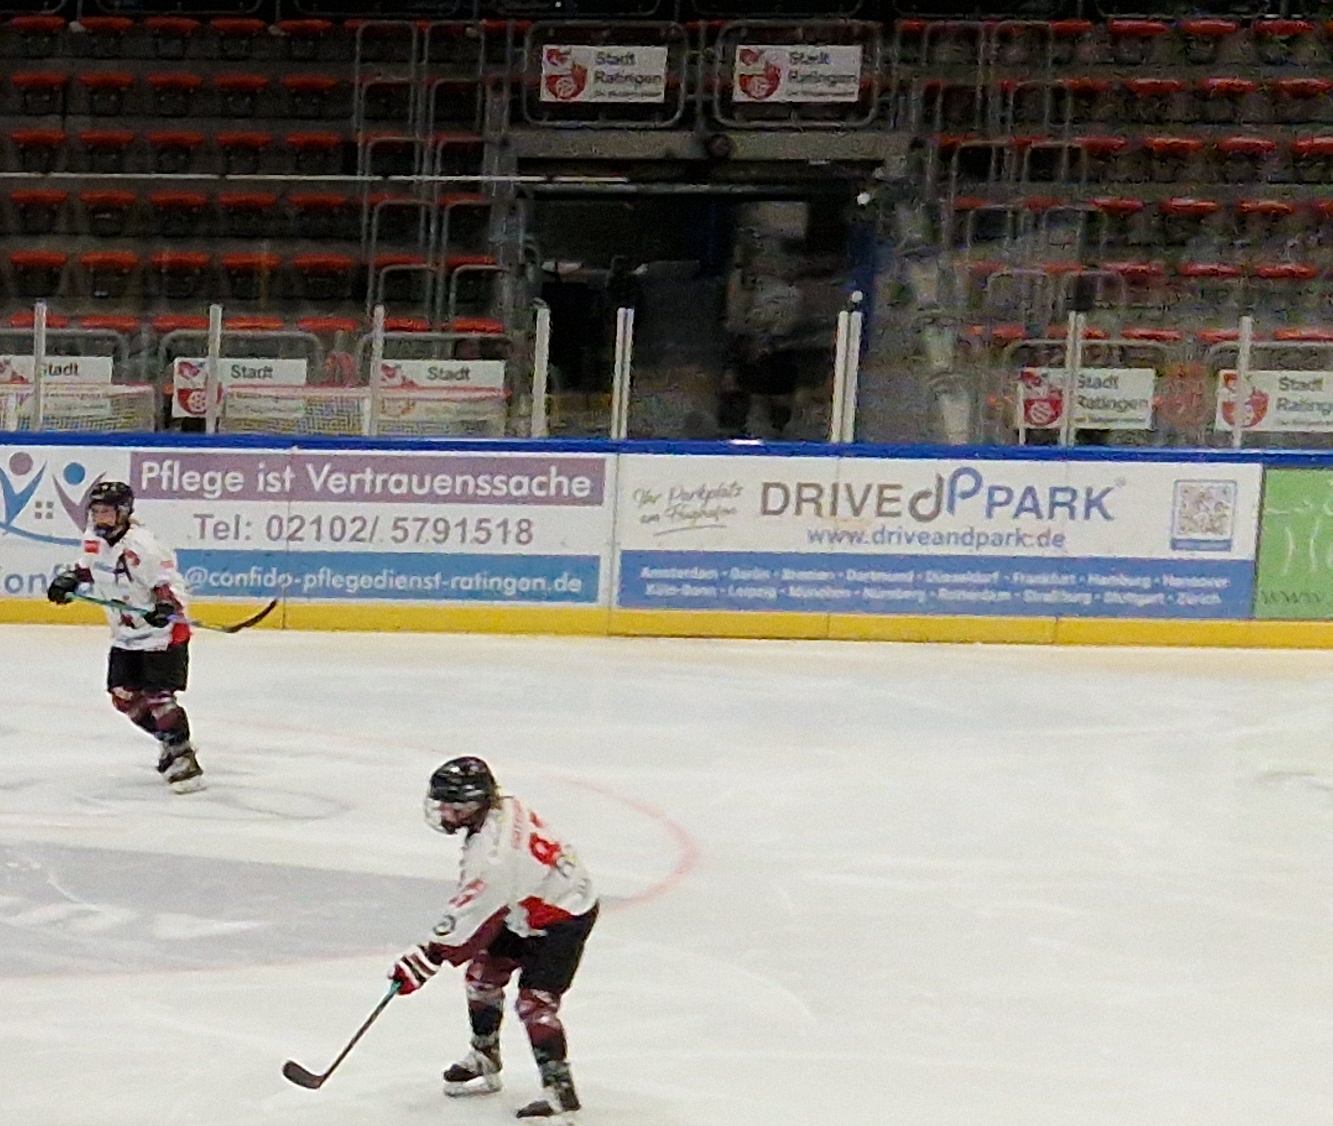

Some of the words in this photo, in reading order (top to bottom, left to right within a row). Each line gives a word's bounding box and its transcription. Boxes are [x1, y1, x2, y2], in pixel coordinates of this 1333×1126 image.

[231, 364, 273, 380] Stadt
[427, 366, 471, 382] Stadt
[1277, 377, 1324, 392] Stadt
[140, 460, 244, 499] Pflege
[257, 463, 295, 492] ist
[306, 463, 592, 498] Vertrauenssache
[759, 480, 903, 519] DRIVE
[985, 484, 1115, 521] PARK
[194, 514, 253, 543] Tel:
[265, 514, 380, 545] 02102/
[389, 515, 534, 545] 5791518
[807, 526, 1067, 550] www.driveandpark.de
